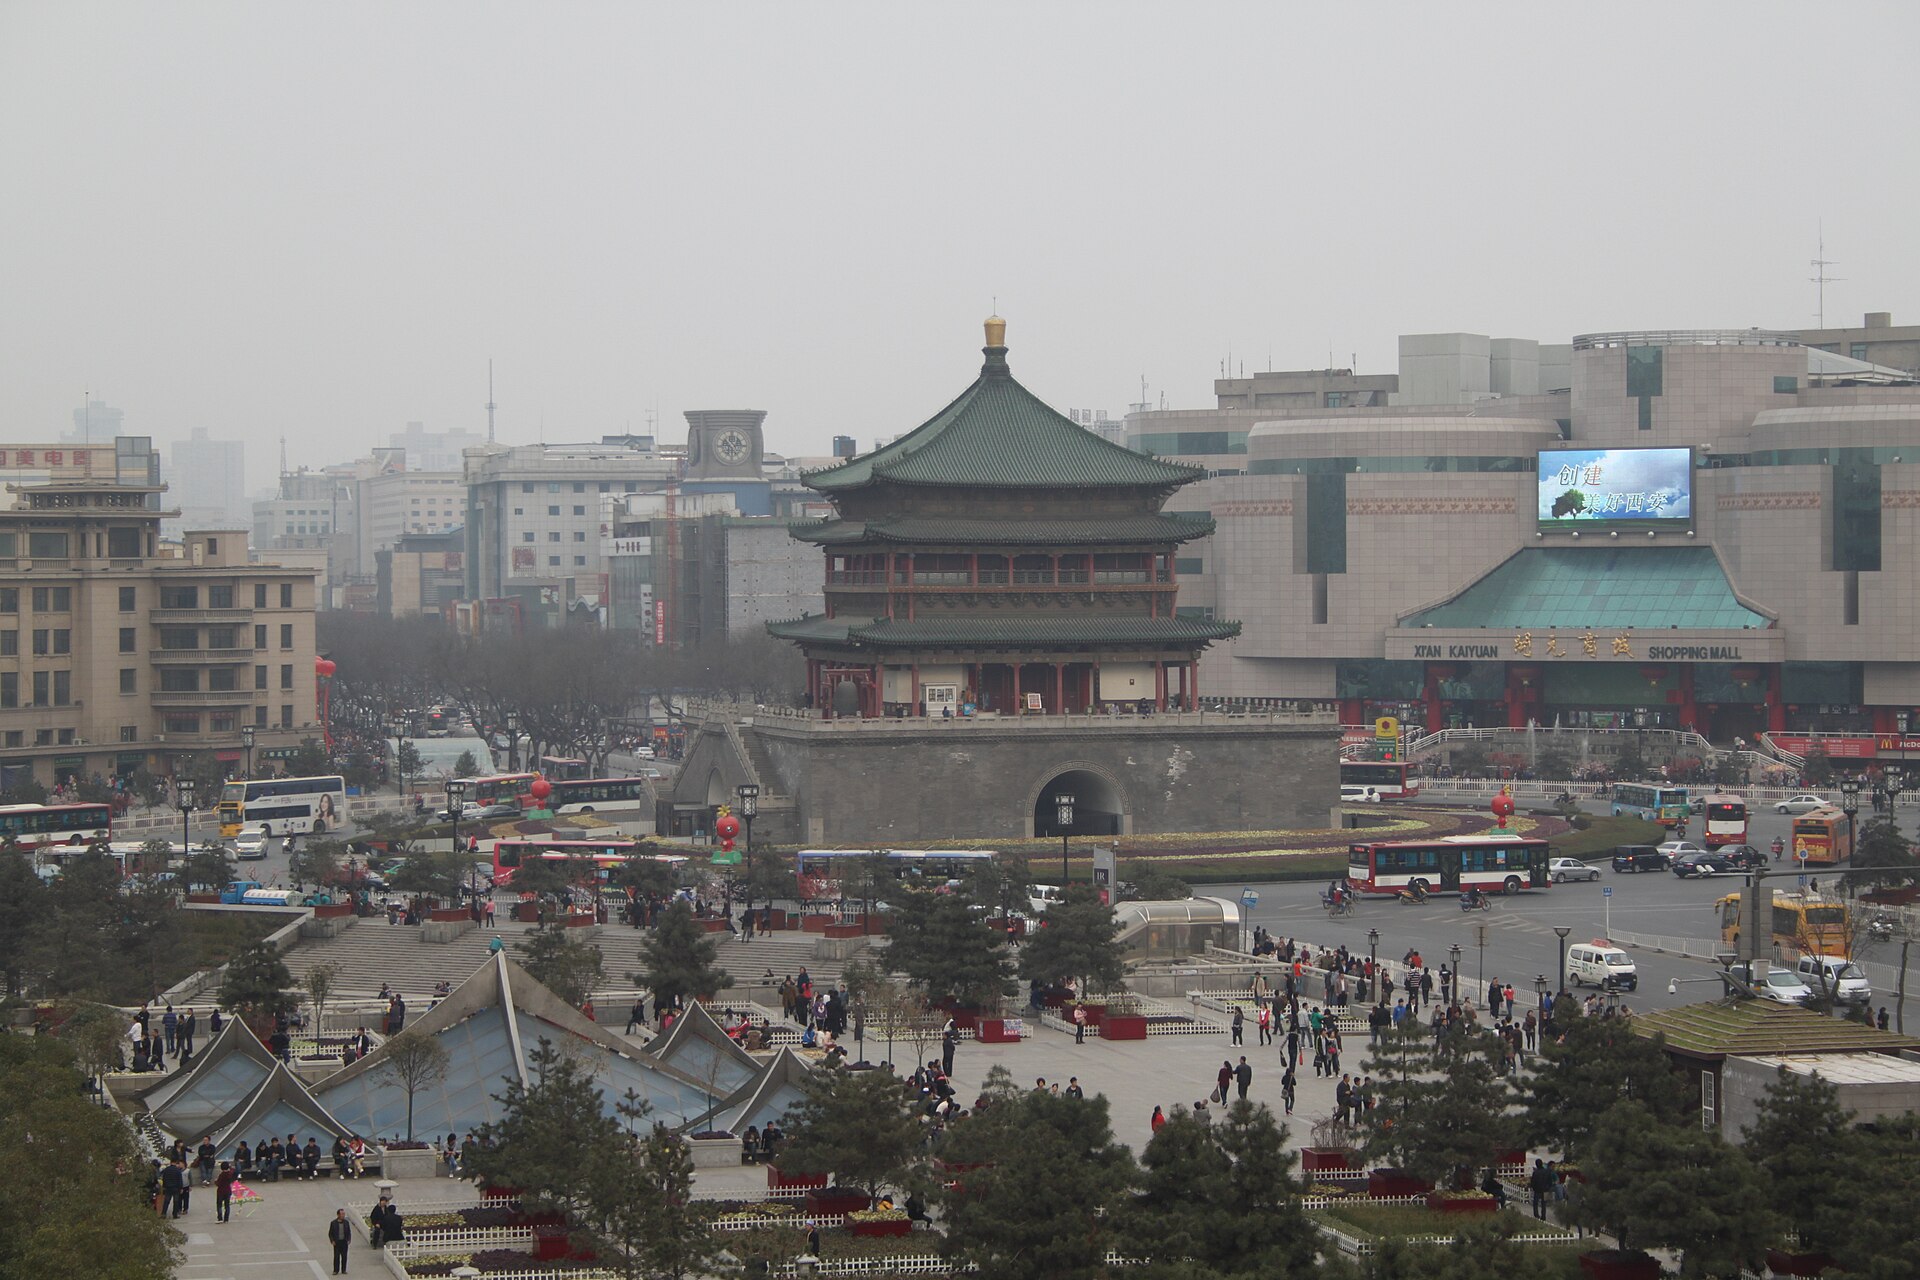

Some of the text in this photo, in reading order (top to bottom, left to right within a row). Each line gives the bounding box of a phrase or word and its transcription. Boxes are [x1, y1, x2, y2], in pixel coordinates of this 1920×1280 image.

[1558, 464, 1602, 486] 创建
[1583, 492, 1668, 513] 美好西安
[1414, 645, 1441, 658] XI'AN
[1450, 645, 1498, 658] KAIYUAN
[1649, 646, 1708, 660] SHOPPING
[1710, 646, 1742, 660] MALL
